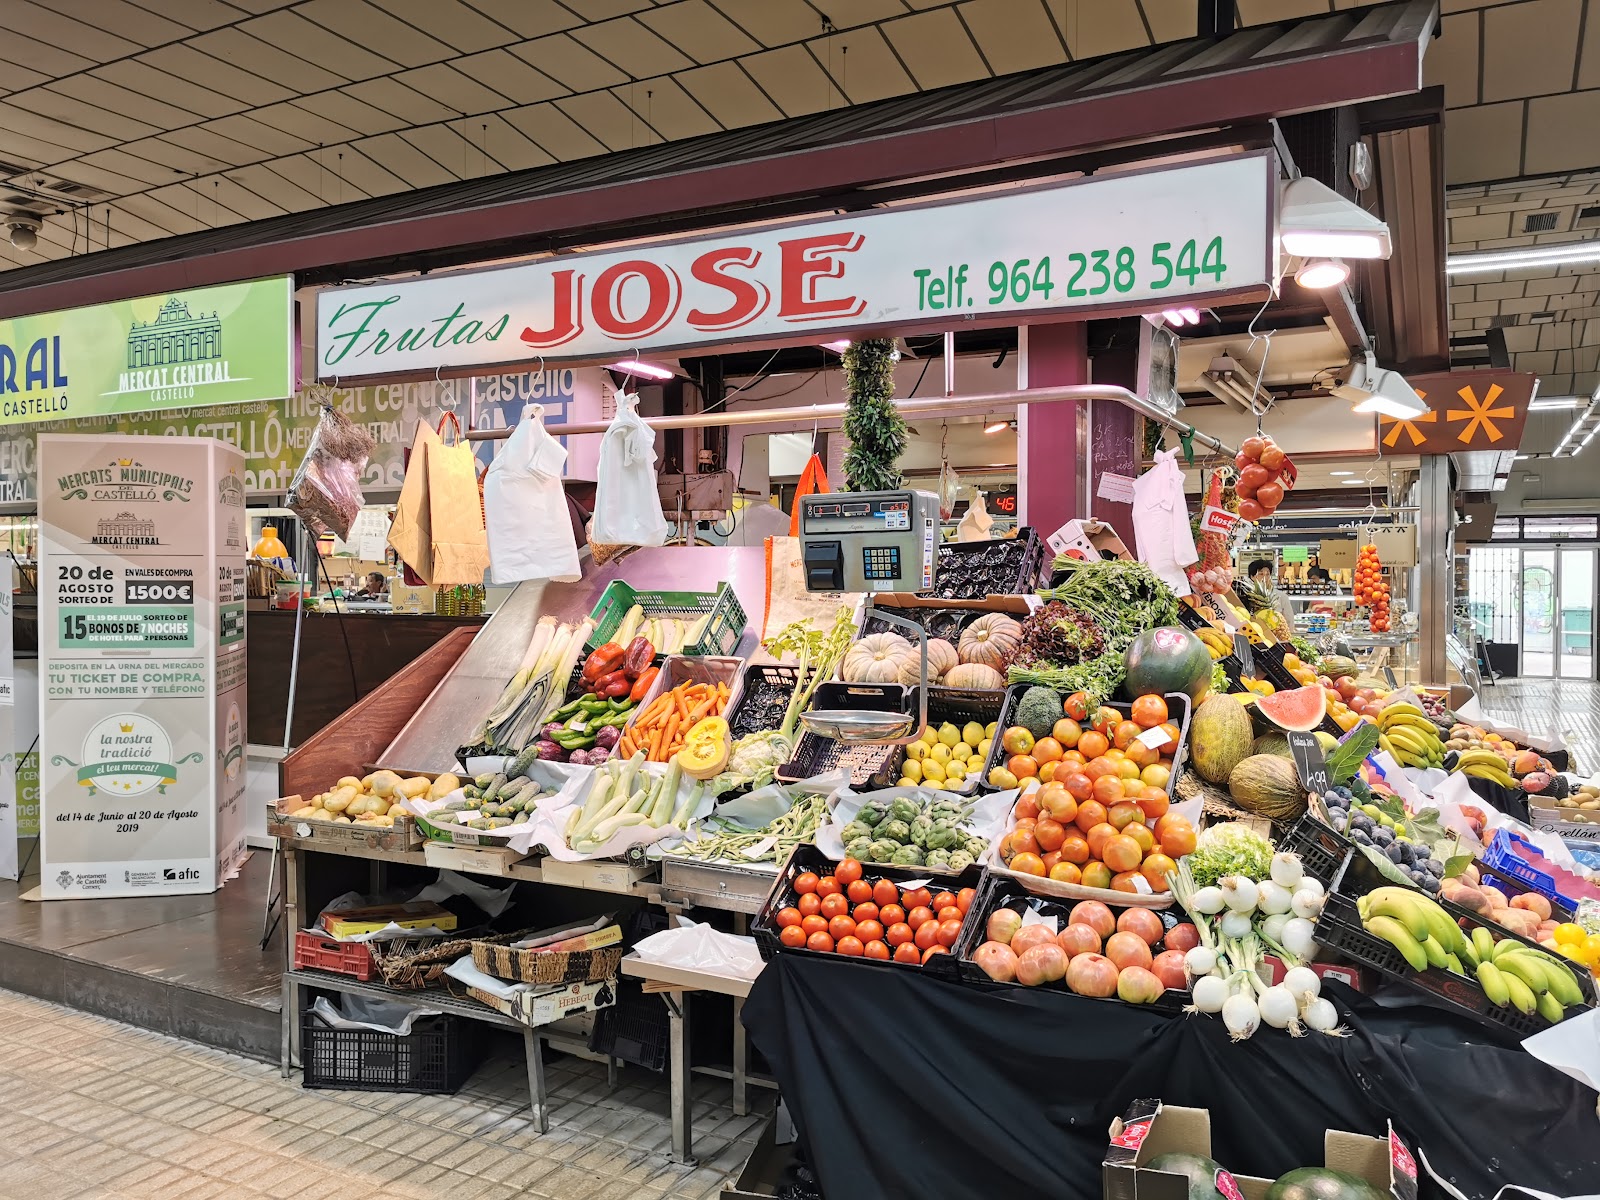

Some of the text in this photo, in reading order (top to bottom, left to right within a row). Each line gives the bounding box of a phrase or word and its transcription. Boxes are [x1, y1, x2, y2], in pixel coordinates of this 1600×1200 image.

[913, 235, 1227, 310] Telf. 964 238 544
[322, 231, 867, 367] Frutas JOSE
[119, 360, 230, 392] MERCAT CENTRAL
[150, 386, 195, 402] CASTELLÓ
[3, 391, 68, 417] CASTELLÓ
[192, 408, 216, 418] mercat
[217, 405, 240, 416] central
[241, 401, 269, 415] castelló
[57, 468, 113, 492] MERCATS
[119, 468, 194, 494] MUNICIPALS
[94, 488, 156, 500] CASTELLÓ
[996, 496, 1015, 511] 46
[92, 536, 160, 545] MERCAT CENTRAL
[58, 566, 114, 580] 20 de
[125, 568, 193, 577] EN VALES DE COMPRA
[58, 583, 114, 593] AGOSTO
[127, 585, 191, 600] 1500€
[58, 596, 114, 604] SORTEO DE
[64, 615, 87, 640] 15
[88, 622, 189, 634] BONOS DE 7 NOCHES
[48, 663, 89, 671] DEPOSITA
[118, 662, 142, 670] URNA
[144, 662, 161, 670] DEL
[163, 662, 205, 670] MERCADO
[49, 672, 206, 684] TU TICKET DE COMPRA,
[48, 683, 206, 695] CON TU NOMBRE Y TELÉFONO
[100, 734, 153, 744] la nostra
[100, 746, 152, 758] tradició
[106, 764, 120, 772] teu
[122, 764, 160, 772] mercat!
[56, 809, 199, 823] del 14 de Junio al 20 de Agosto
[116, 823, 140, 833] 2019
[178, 868, 200, 880] afic
[558, 993, 594, 1009] HEBEGU
